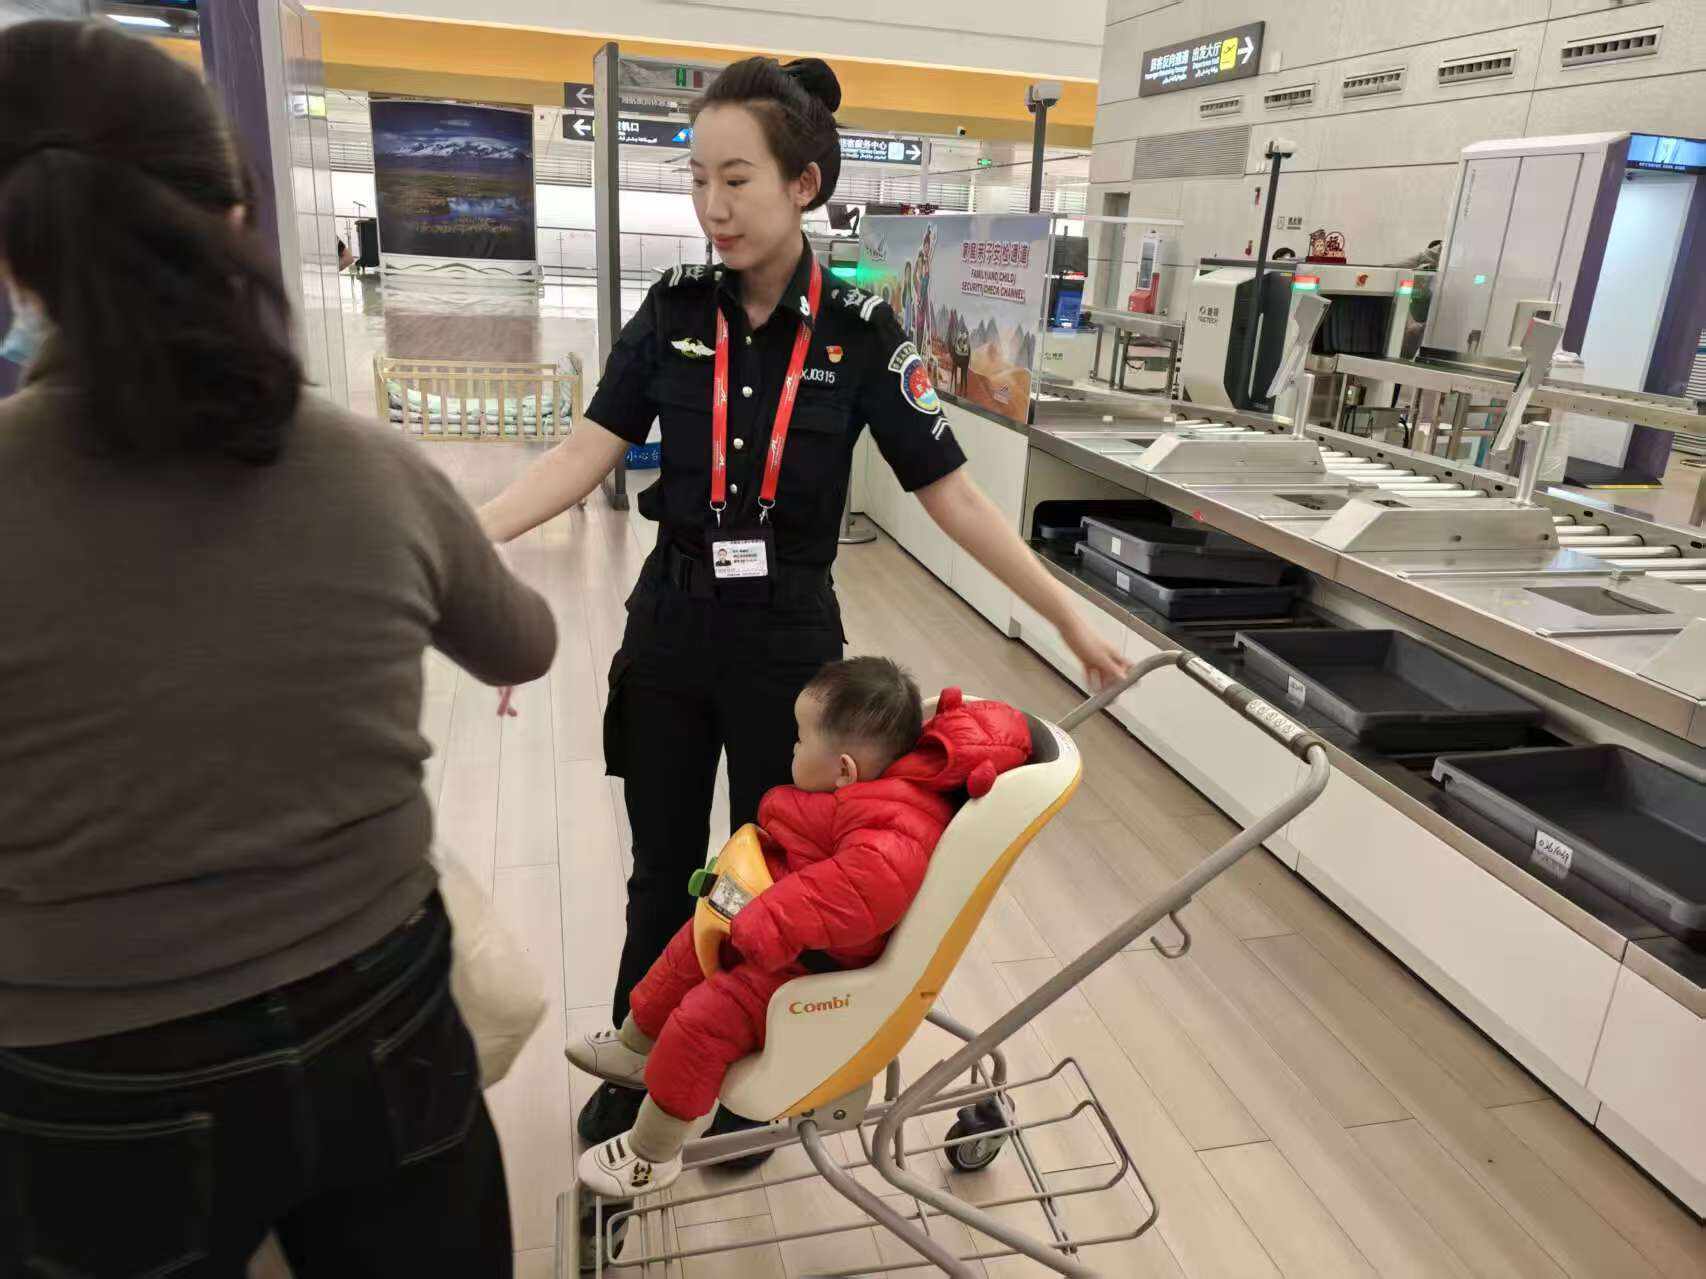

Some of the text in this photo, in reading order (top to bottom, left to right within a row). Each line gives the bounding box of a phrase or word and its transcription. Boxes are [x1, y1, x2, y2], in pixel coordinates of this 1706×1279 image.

[1192, 41, 1222, 62] 出发大厅
[961, 280, 1025, 300] SECURITY CHECK CHANNEL
[789, 993, 851, 1015] Combi
